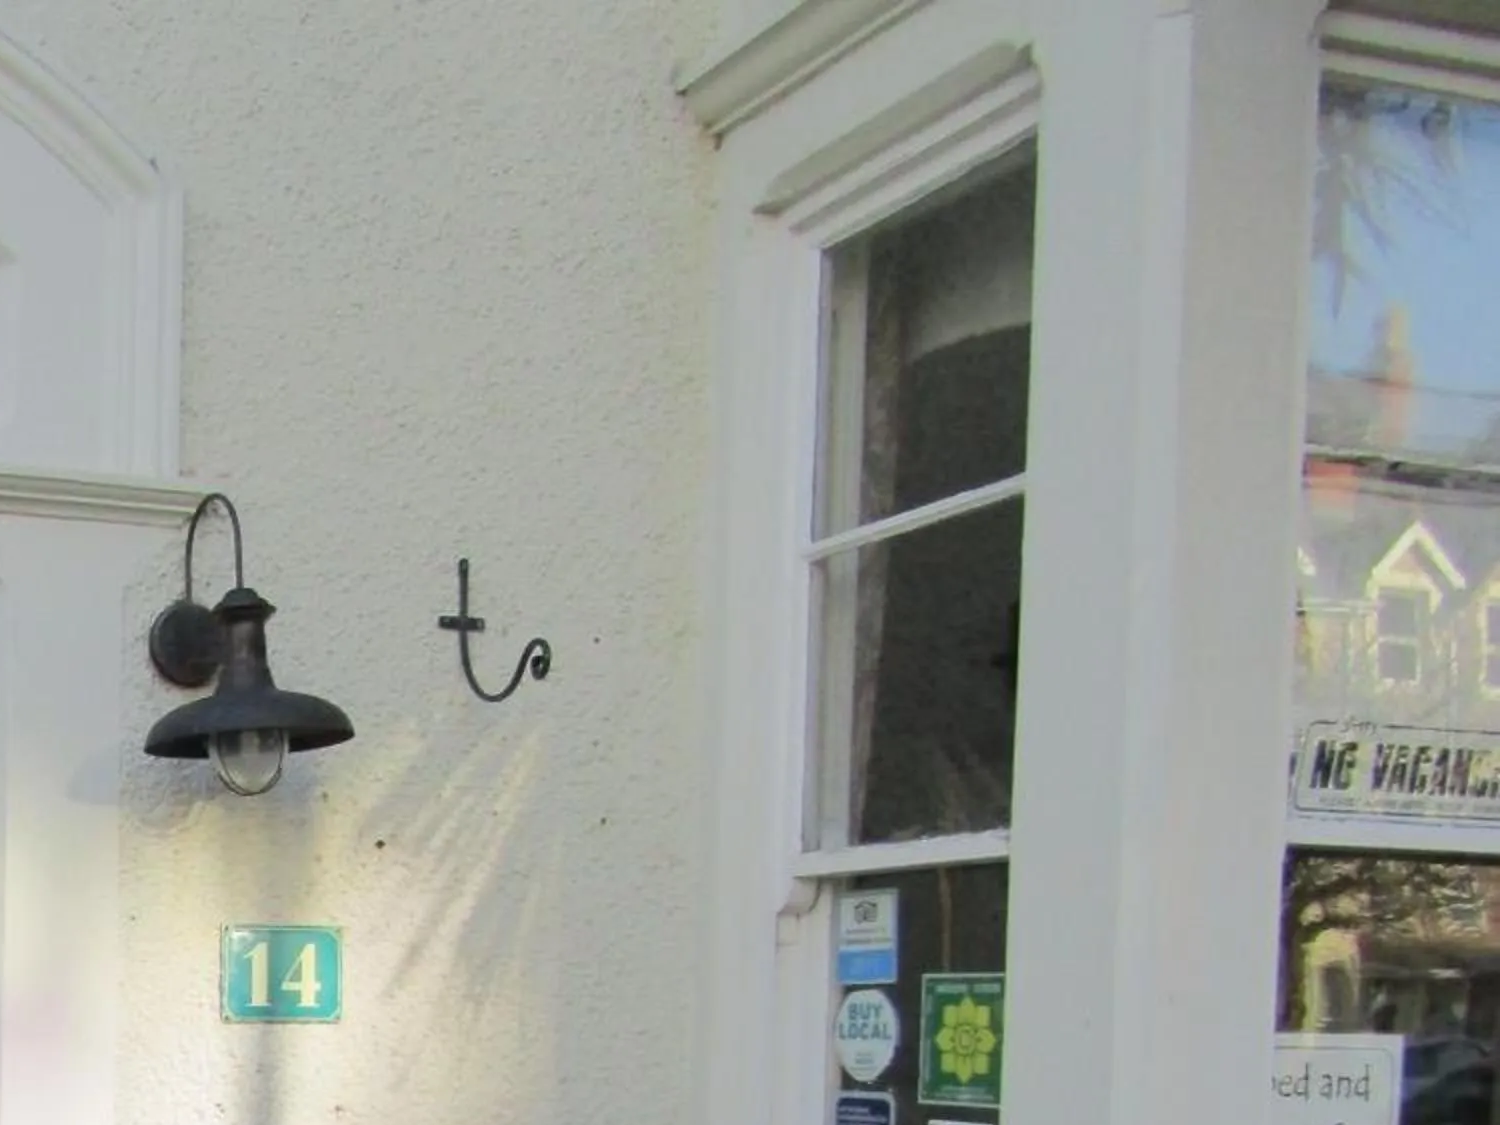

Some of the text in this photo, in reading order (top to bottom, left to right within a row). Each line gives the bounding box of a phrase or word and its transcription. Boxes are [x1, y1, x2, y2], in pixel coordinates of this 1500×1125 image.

[243, 941, 322, 1008] 14
[838, 1022, 893, 1040] LOCAL
[1271, 1062, 1370, 1101] ed and
